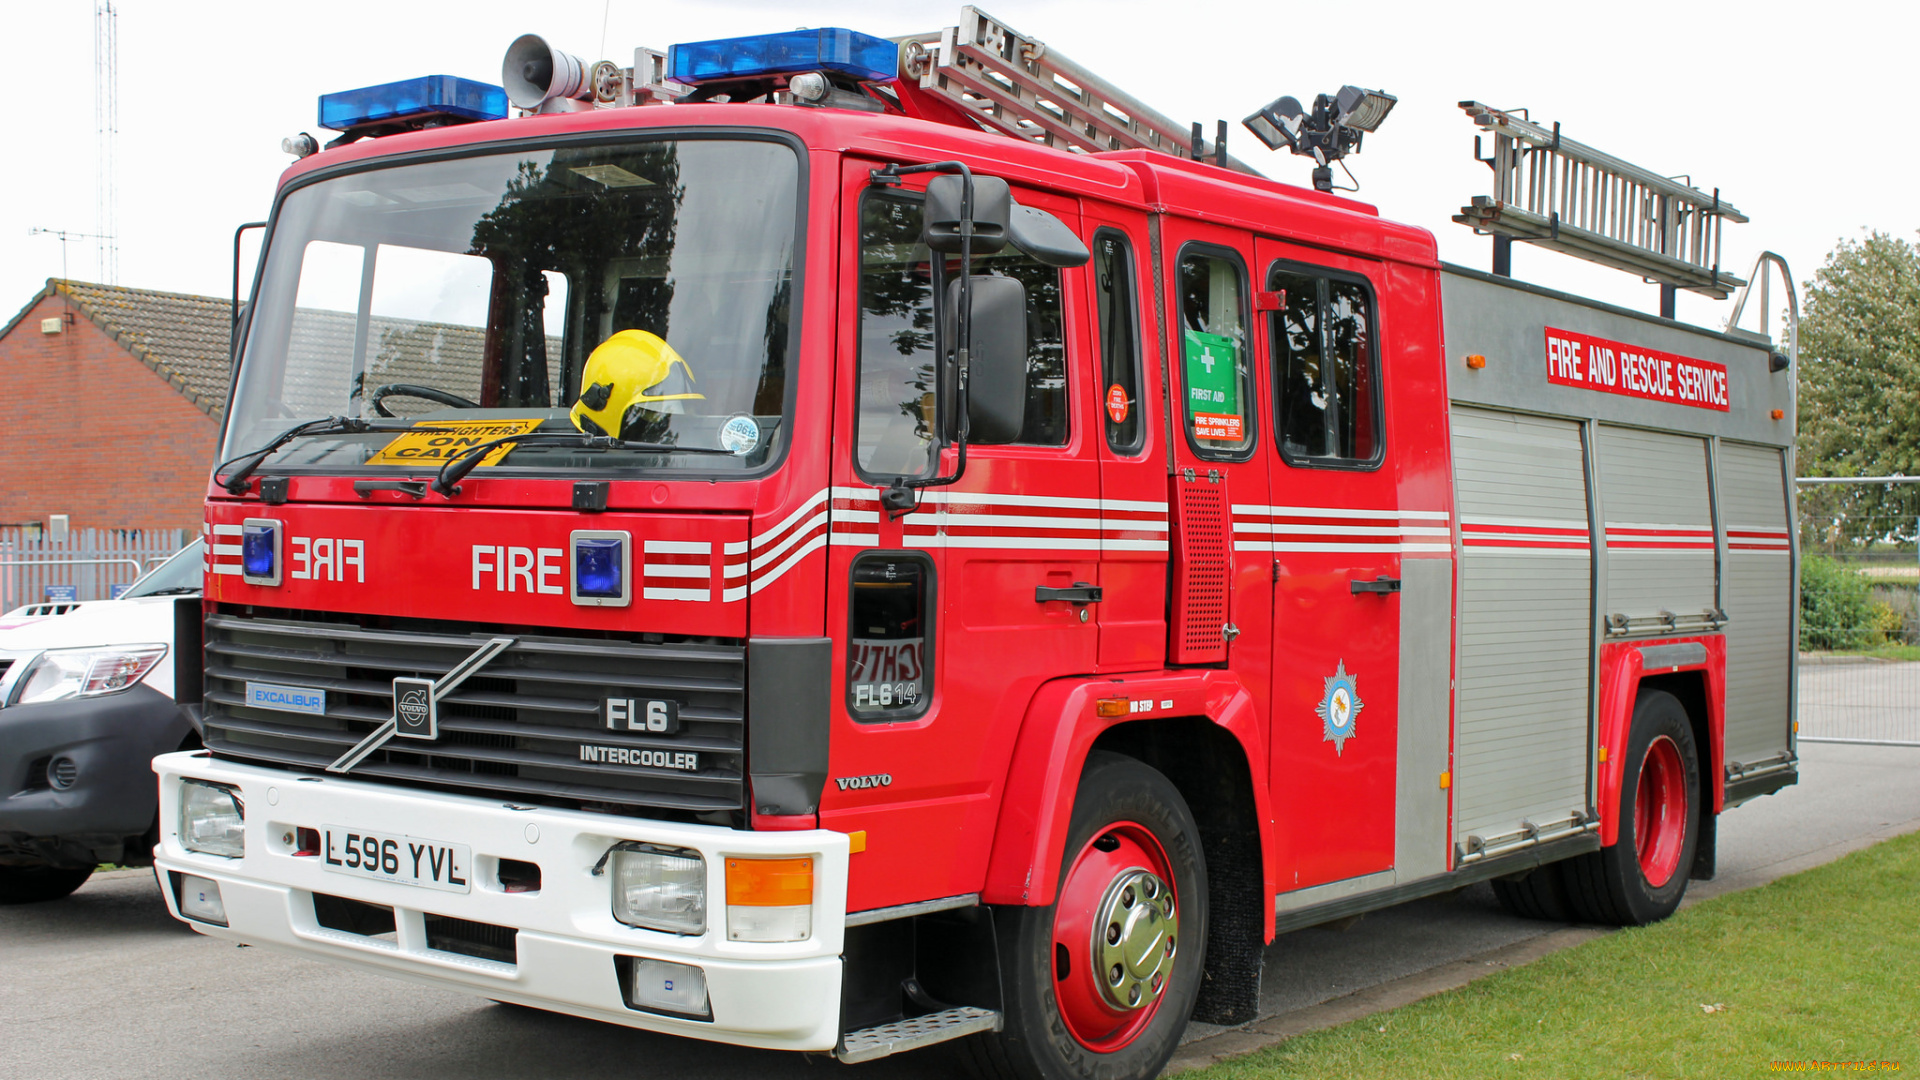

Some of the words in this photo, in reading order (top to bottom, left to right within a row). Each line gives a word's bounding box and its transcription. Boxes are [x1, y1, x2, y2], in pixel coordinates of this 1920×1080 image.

[1548, 336, 1583, 381] FIRE
[1589, 345, 1616, 386] AND
[1620, 352, 1674, 397] RESCUE
[1677, 363, 1728, 406] SERVICE
[1191, 387, 1212, 401] FIRST
[1213, 390, 1225, 403] AID
[1195, 416, 1207, 425] FIRE
[1209, 417, 1240, 427] SPRINKLERS
[1196, 427, 1210, 436] SAVE
[1211, 428, 1226, 437] LIVES
[428, 437, 482, 446] ON
[472, 544, 563, 595] FIRE
[255, 690, 321, 708] EXCALIBUR
[400, 704, 427, 714] VOLVO
[606, 698, 667, 732] FL6
[580, 745, 697, 770] INTERCOOLER
[835, 773, 892, 790] VOLVO
[326, 831, 398, 874] L596
[408, 843, 466, 886] YVL
